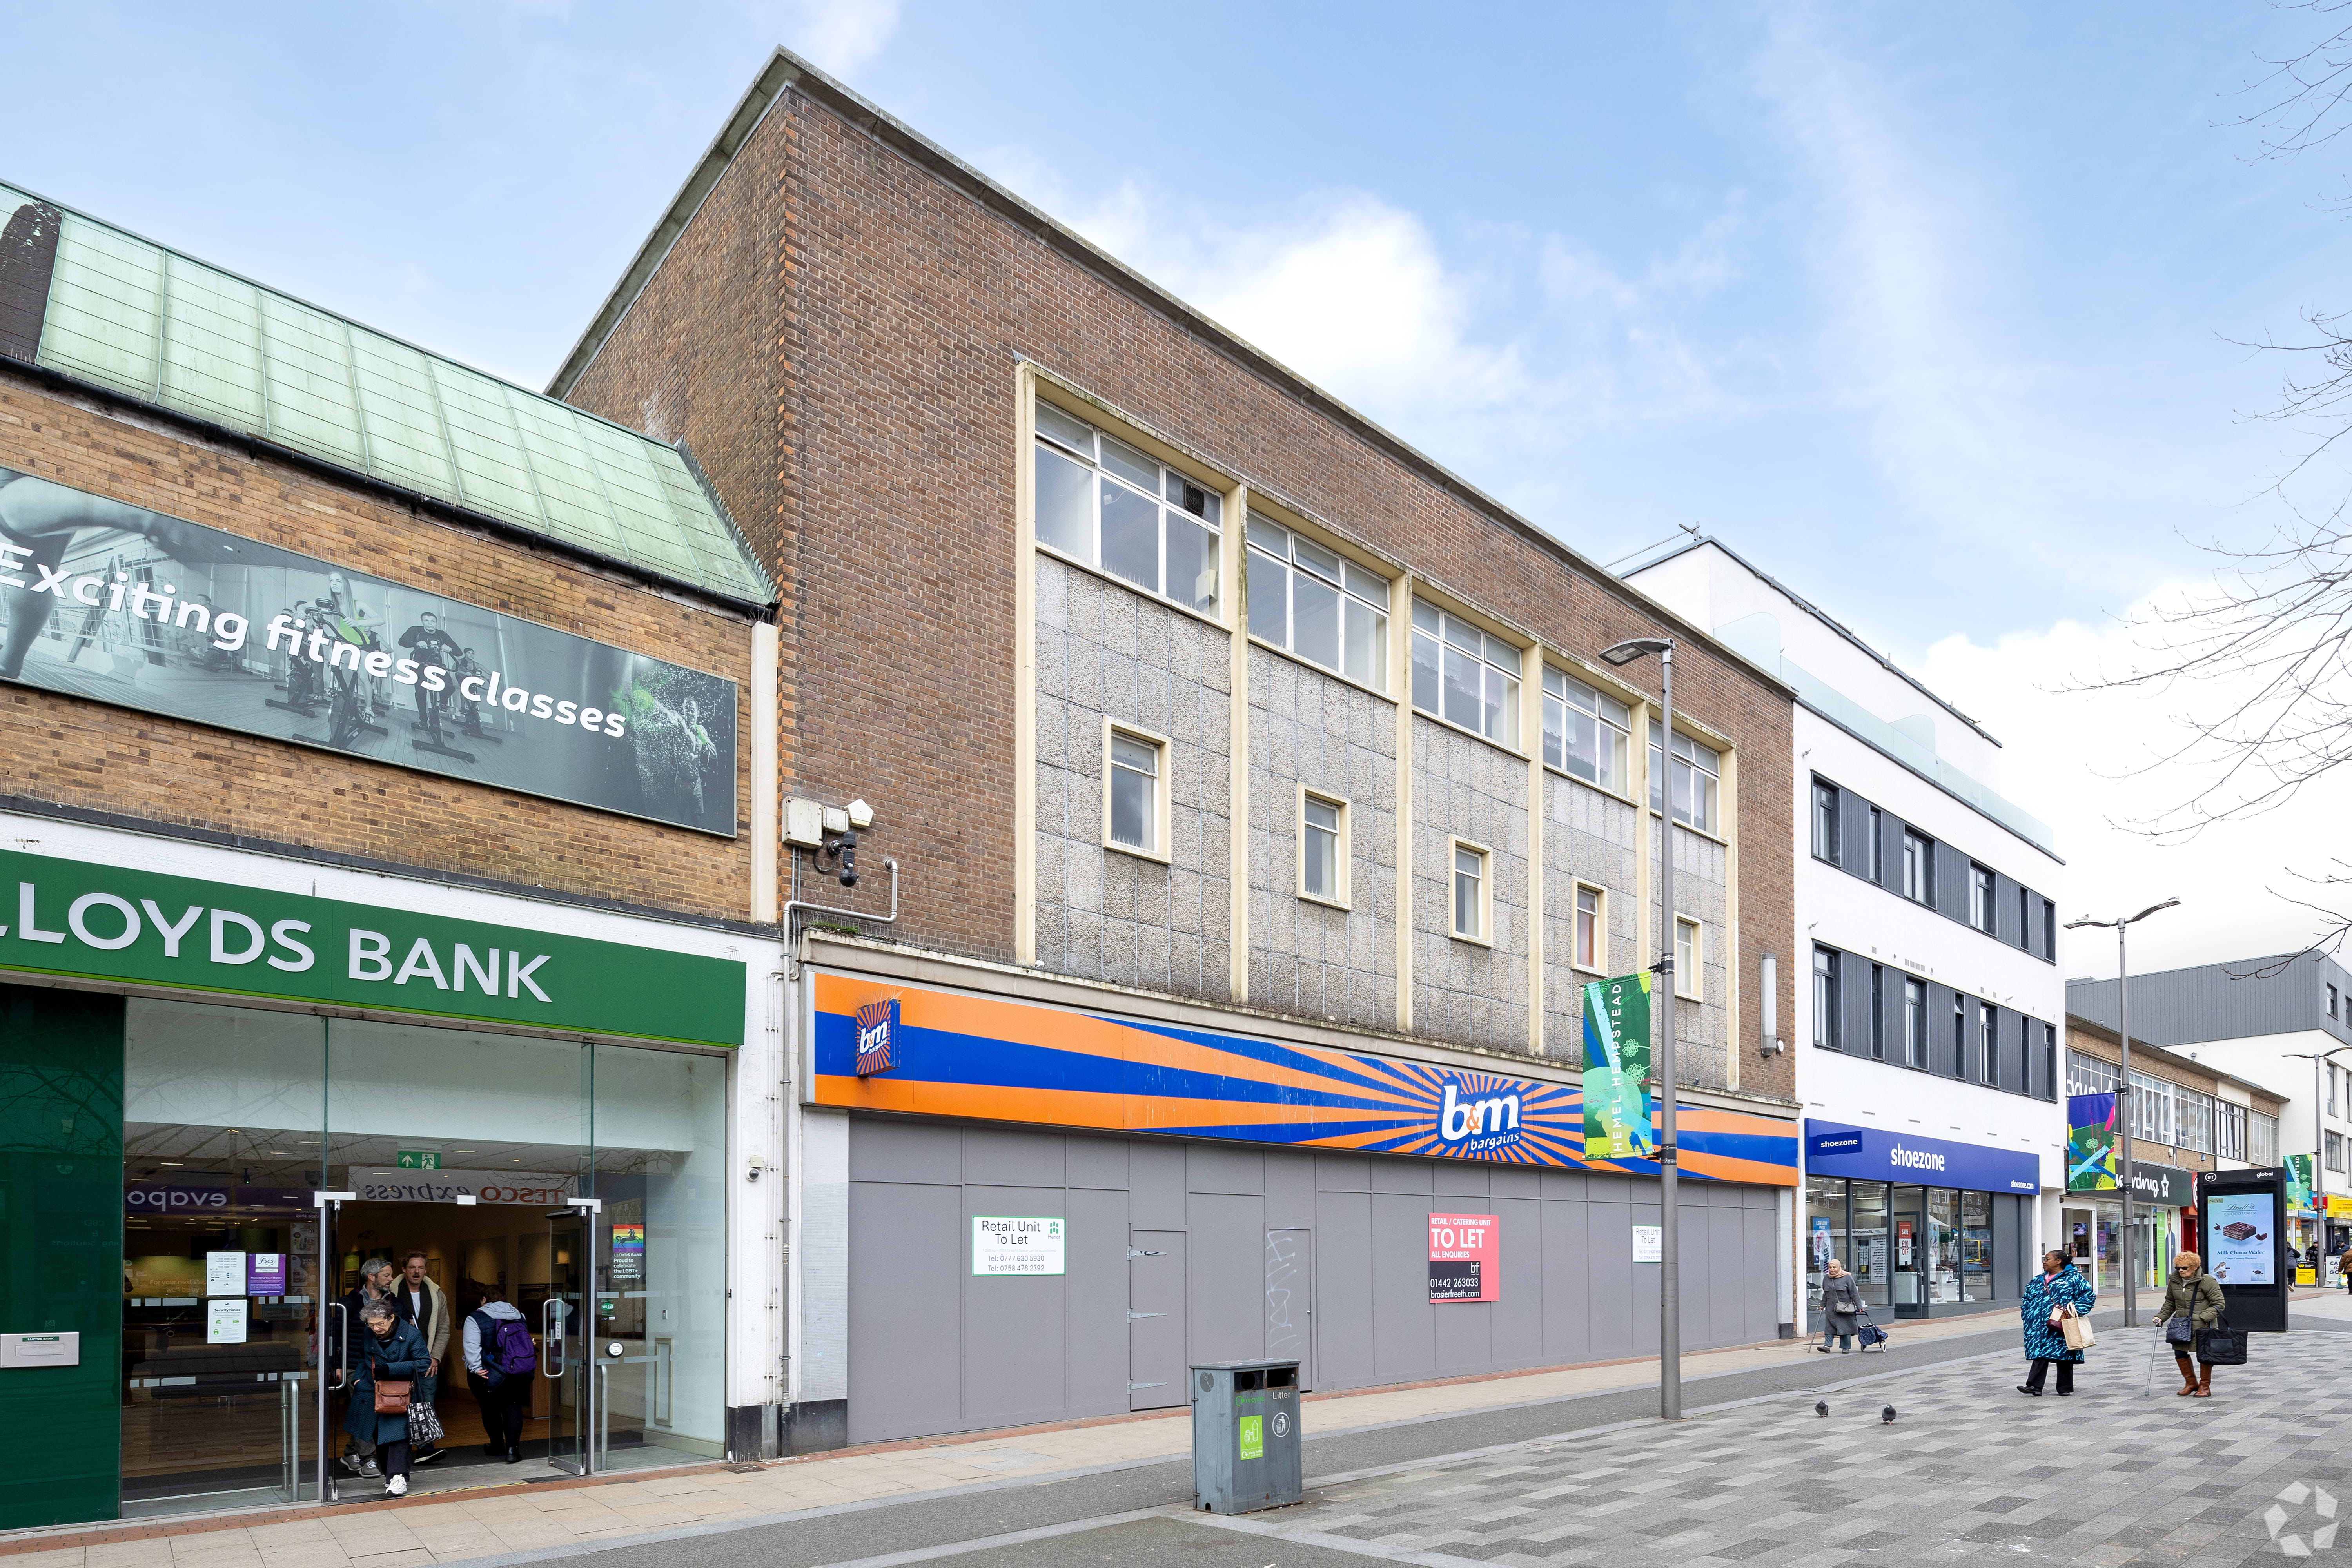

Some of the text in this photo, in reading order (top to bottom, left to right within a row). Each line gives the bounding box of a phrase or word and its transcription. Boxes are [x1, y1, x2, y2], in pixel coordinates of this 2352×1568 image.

[0, 542, 626, 737] Exciting fitness classes
[0, 882, 552, 1002] LOYDS BANK
[859, 1021, 888, 1053] b&m
[869, 1038, 887, 1054] bargains
[1611, 984, 1622, 1152] HEMEL HEMPSTEAD
[1441, 1085, 1520, 1141] b&m
[1470, 1132, 1519, 1151] bargains
[1821, 1139, 1858, 1148] shoezone
[1891, 1143, 1945, 1171] shoezone
[2011, 1179, 2034, 1189] shoezone.com
[982, 1220, 1041, 1232] Retail Unit
[995, 1234, 1028, 1244] To Let
[1431, 1228, 1485, 1248] TO LET
[1430, 1278, 1478, 1287] 01442 263033
[1431, 1289, 1480, 1298] brasierfreeth.com
[1245, 1396, 1265, 1404] recycle
[1272, 1391, 1291, 1400] Litter
